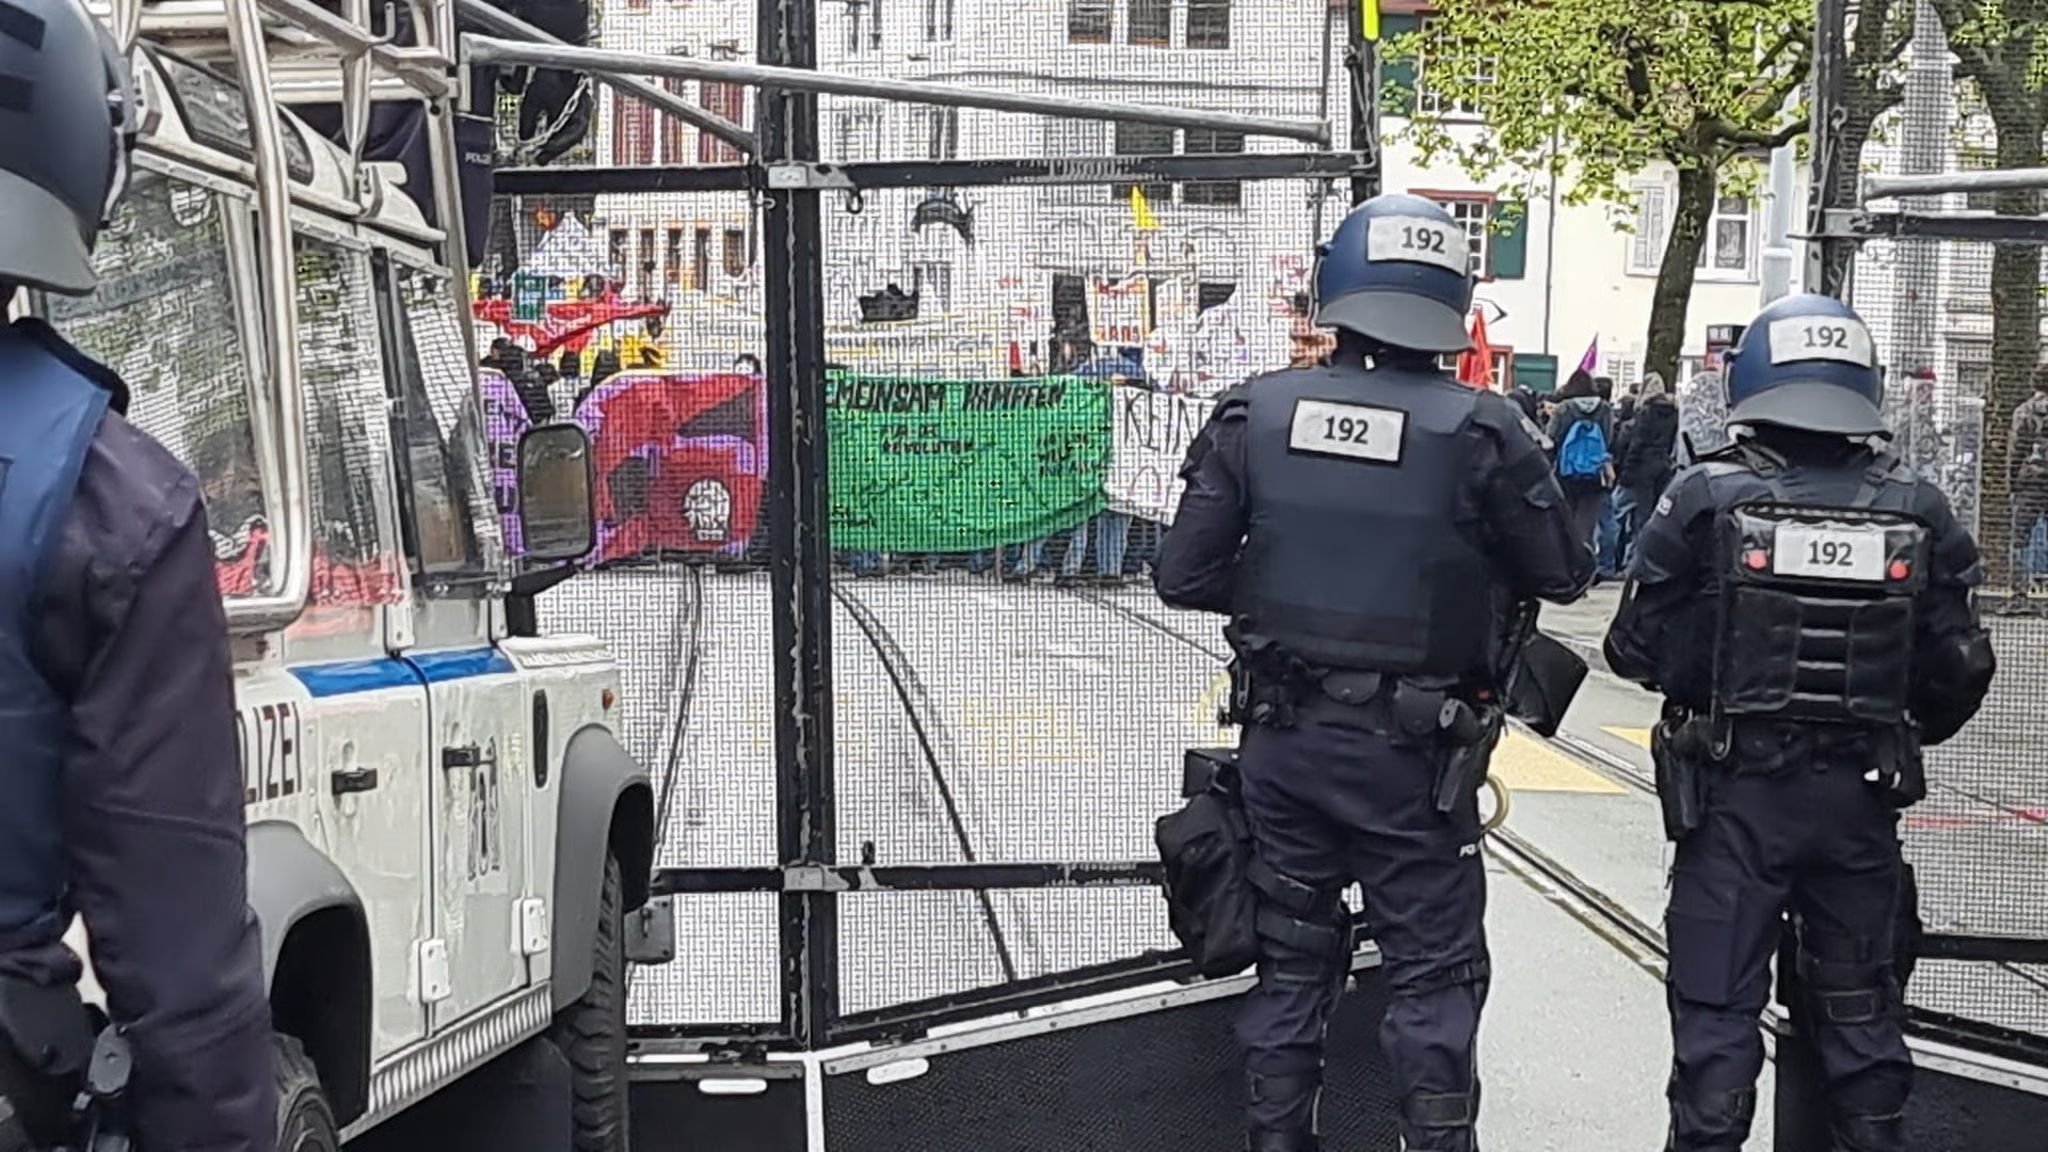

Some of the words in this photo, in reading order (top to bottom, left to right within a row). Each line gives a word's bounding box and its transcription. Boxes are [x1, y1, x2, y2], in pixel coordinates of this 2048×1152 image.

[1401, 226, 1446, 254] 192
[1803, 326, 1848, 349] 192
[826, 379, 946, 415] EMEINSAM
[1323, 416, 1369, 445] 192
[1807, 541, 1854, 567] 192
[235, 701, 302, 804] LIZEI
